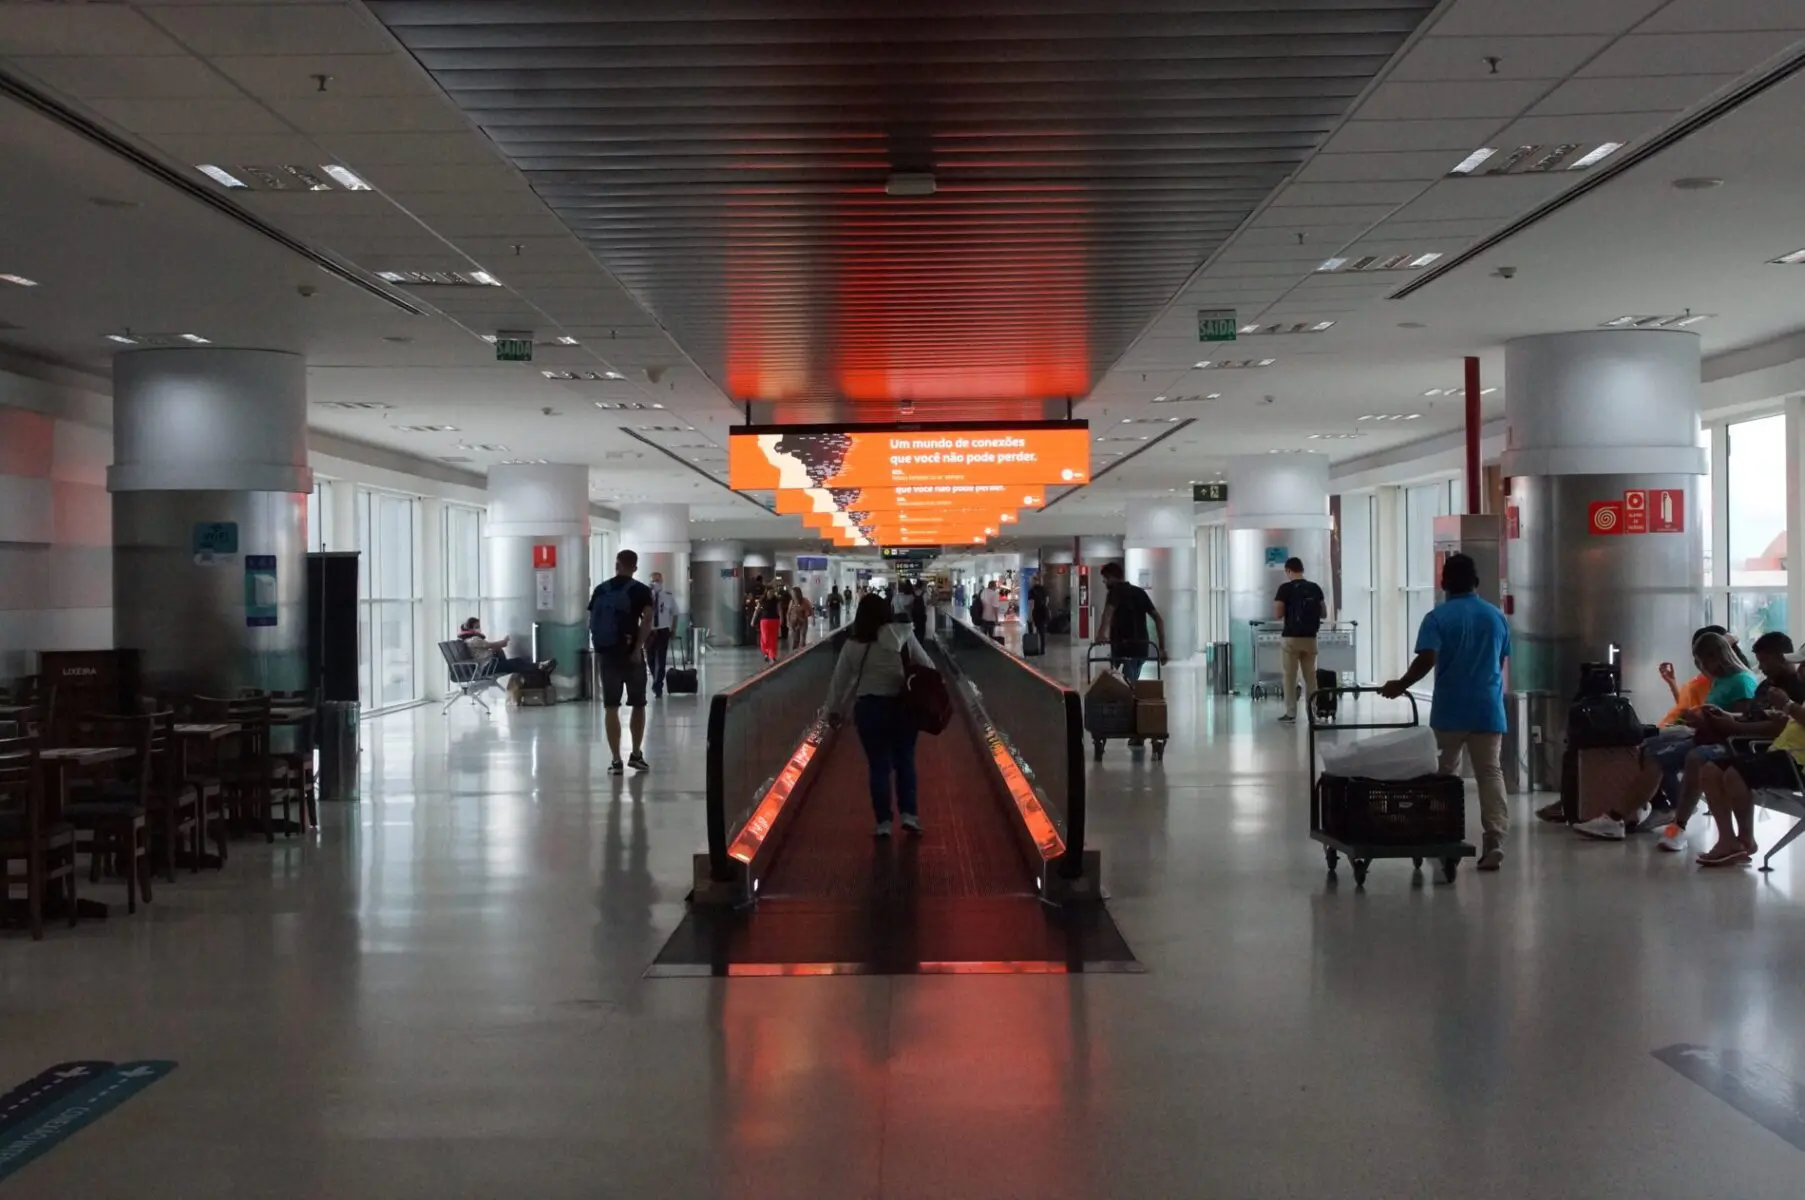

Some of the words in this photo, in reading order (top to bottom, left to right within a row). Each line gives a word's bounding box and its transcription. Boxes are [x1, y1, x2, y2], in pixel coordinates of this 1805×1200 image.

[890, 438, 910, 449] Um
[912, 437, 952, 449] mundo
[955, 437, 969, 448] de
[971, 436, 1025, 448] conexões
[890, 454, 912, 465] que
[914, 452, 940, 463] você
[942, 452, 964, 463] não
[966, 452, 995, 465] pode
[997, 451, 1038, 465] perder.
